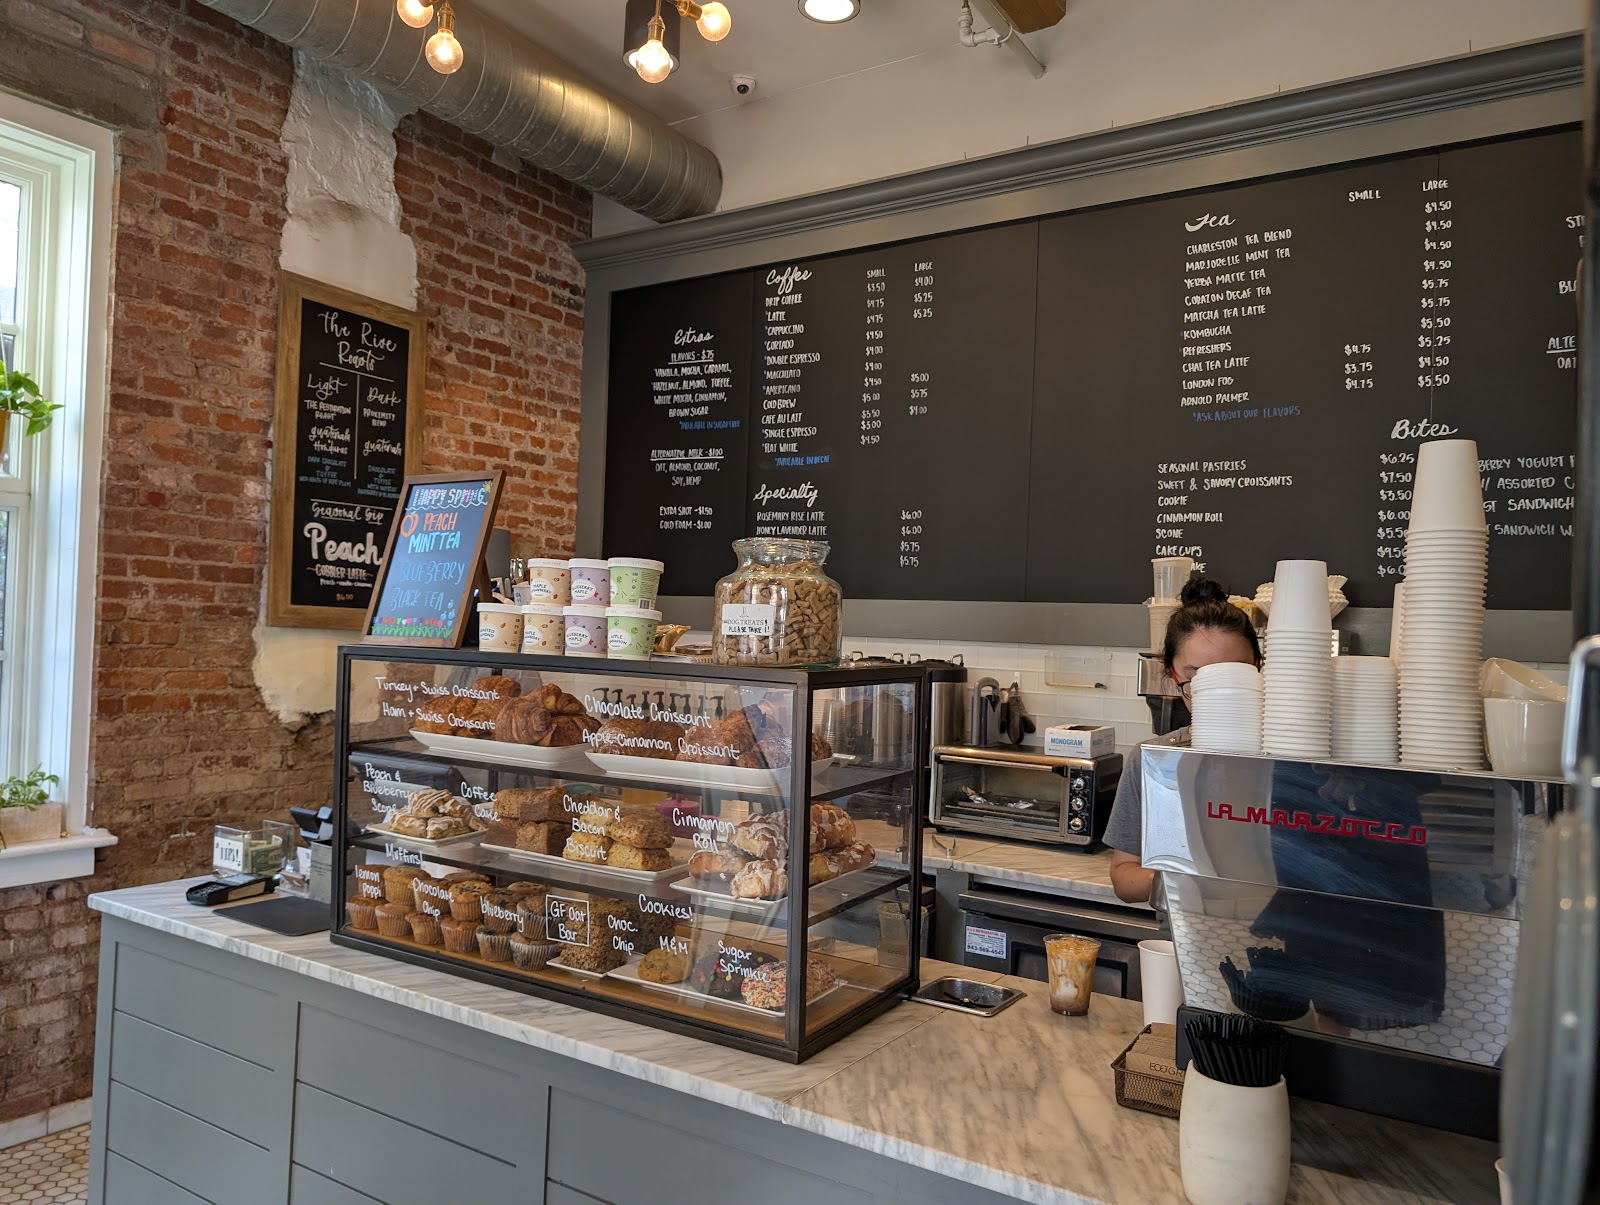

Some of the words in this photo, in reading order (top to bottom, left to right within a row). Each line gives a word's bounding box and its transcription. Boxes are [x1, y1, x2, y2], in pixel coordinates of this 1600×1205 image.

[1423, 180, 1448, 191] LARGE
[1349, 190, 1380, 201] SMALL
[1425, 201, 1451, 214] $4.50
[1185, 213, 1236, 232] Tea
[1425, 220, 1452, 232] $4.50
[1187, 238, 1237, 255] CHARLESTON
[1245, 235, 1259, 245] TEA
[1264, 229, 1291, 242] BLEND
[915, 262, 933, 271] LARGE
[1186, 255, 1240, 272] MARJORELLE
[1246, 250, 1269, 263] MINT
[1276, 248, 1290, 258] TEA
[766, 266, 812, 295] Coffee
[867, 269, 886, 278] SMALL
[1184, 277, 1212, 289] YERBA
[1216, 271, 1245, 285] MATTE
[1249, 269, 1265, 280] TEA
[1422, 279, 1449, 289] $5.75
[766, 296, 780, 307] DRIP
[782, 293, 802, 305] COFFEE
[1185, 293, 1223, 306] CORAZON
[1227, 289, 1251, 301] DECAF
[1256, 286, 1271, 297] TEA
[1421, 297, 1450, 308] $5.75
[1184, 309, 1219, 323] MATCHA
[1223, 307, 1238, 319] TEA
[1242, 305, 1266, 316] LATTE
[317, 311, 351, 337] The
[362, 322, 396, 352] Rise
[1421, 318, 1450, 329] $5.50
[674, 327, 714, 345] Extras
[1418, 335, 1450, 347] $5.25
[1345, 344, 1371, 355] $4.75
[1183, 361, 1203, 373] CHAI
[1205, 359, 1221, 371] TEA
[1225, 357, 1249, 369] LATTE
[1345, 362, 1372, 374] $3.75
[1418, 356, 1449, 367] $4.50
[308, 374, 348, 400] Light
[1183, 377, 1214, 389] LONDON
[1218, 376, 1234, 386] FOG
[1345, 379, 1373, 389] $4.75
[1418, 375, 1450, 387] $5.50
[367, 387, 401, 406] Dark
[763, 399, 777, 410] COLD
[777, 399, 796, 409] BREW
[1181, 395, 1212, 407] ARNOLD
[1216, 392, 1249, 403] PALMER
[669, 409, 689, 417] BROWN
[690, 406, 708, 416] SUGAR
[762, 415, 775, 424] CAFE
[777, 414, 787, 424] AU
[787, 413, 802, 422] LAIT
[1391, 418, 1458, 439] Bites
[1158, 462, 1199, 473] SEASONAL
[1203, 460, 1246, 473] PASTRIES
[1380, 453, 1414, 464] $6.25
[1517, 456, 1564, 468] YOGURT
[1158, 480, 1185, 490] SWEET
[1190, 478, 1197, 491] &
[1204, 477, 1236, 490] SAVORY
[1238, 476, 1292, 487] CROISSANTS
[1380, 472, 1411, 483] $7.50
[1497, 477, 1555, 489] ASSORTED
[753, 481, 818, 507] Specialty
[1158, 496, 1188, 506] COOKIE
[1380, 491, 1411, 501] $3.50
[660, 506, 677, 516] EXTRA
[678, 506, 692, 515] SHOT
[1508, 497, 1574, 511] SANDWICH
[423, 512, 458, 531] PEACH
[660, 520, 674, 529] COLD
[675, 521, 692, 529] FOAM
[757, 511, 789, 521] ROSEMARY
[791, 512, 804, 521] RISE
[807, 512, 825, 521] LATTE
[1157, 513, 1203, 523] CINNAMON
[1205, 513, 1223, 522] ROLL
[756, 526, 776, 536] HONEY
[777, 526, 807, 536] LAVENDER
[808, 526, 827, 535] LATTE
[1156, 529, 1183, 539] SCONE
[1495, 524, 1555, 535] SANDWICH
[304, 522, 382, 565] Peach
[408, 532, 440, 553] MINT
[439, 531, 460, 550] TEA
[1156, 545, 1177, 556] CAKE
[1179, 546, 1202, 557] CUPS
[400, 561, 465, 584] BLUEBERRY
[390, 588, 420, 611] BLACK
[425, 591, 444, 611] TEA
[375, 676, 413, 702] Turkey
[421, 681, 449, 696] Swiss
[452, 686, 500, 701] Croissant
[383, 702, 406, 718] Ham
[416, 709, 445, 723] Swiss
[448, 714, 496, 730] Croissant
[585, 694, 644, 719] Chocolate
[650, 703, 712, 728] Croissant
[677, 737, 741, 760] Croissant
[1051, 738, 1082, 746] MONOGRAM
[365, 763, 393, 781] Peach
[461, 782, 497, 802] Coffee
[475, 805, 501, 822] Cake
[563, 795, 613, 818] Cheddar
[614, 806, 621, 822] &
[571, 818, 605, 836] Bacon
[673, 808, 735, 834] Cinnamon
[1208, 802, 1232, 820] LA
[1247, 806, 1426, 844] MARZOCCO
[566, 838, 607, 859] Biscuit
[692, 833, 718, 852] Roll
[385, 843, 423, 867] Muffins!
[355, 865, 379, 882] lemon
[412, 877, 454, 903] Chocolate
[422, 901, 441, 921] Chip
[480, 896, 524, 932] blueberry
[550, 901, 565, 918] GF
[569, 908, 586, 923] Oat
[638, 893, 693, 922] Cookies!
[558, 923, 578, 941] Bar
[607, 915, 638, 933] Choc.
[613, 936, 634, 955] Chip
[660, 936, 688, 955] M&M
[718, 940, 752, 962] Sugar
[720, 959, 771, 983] Sprinkle
